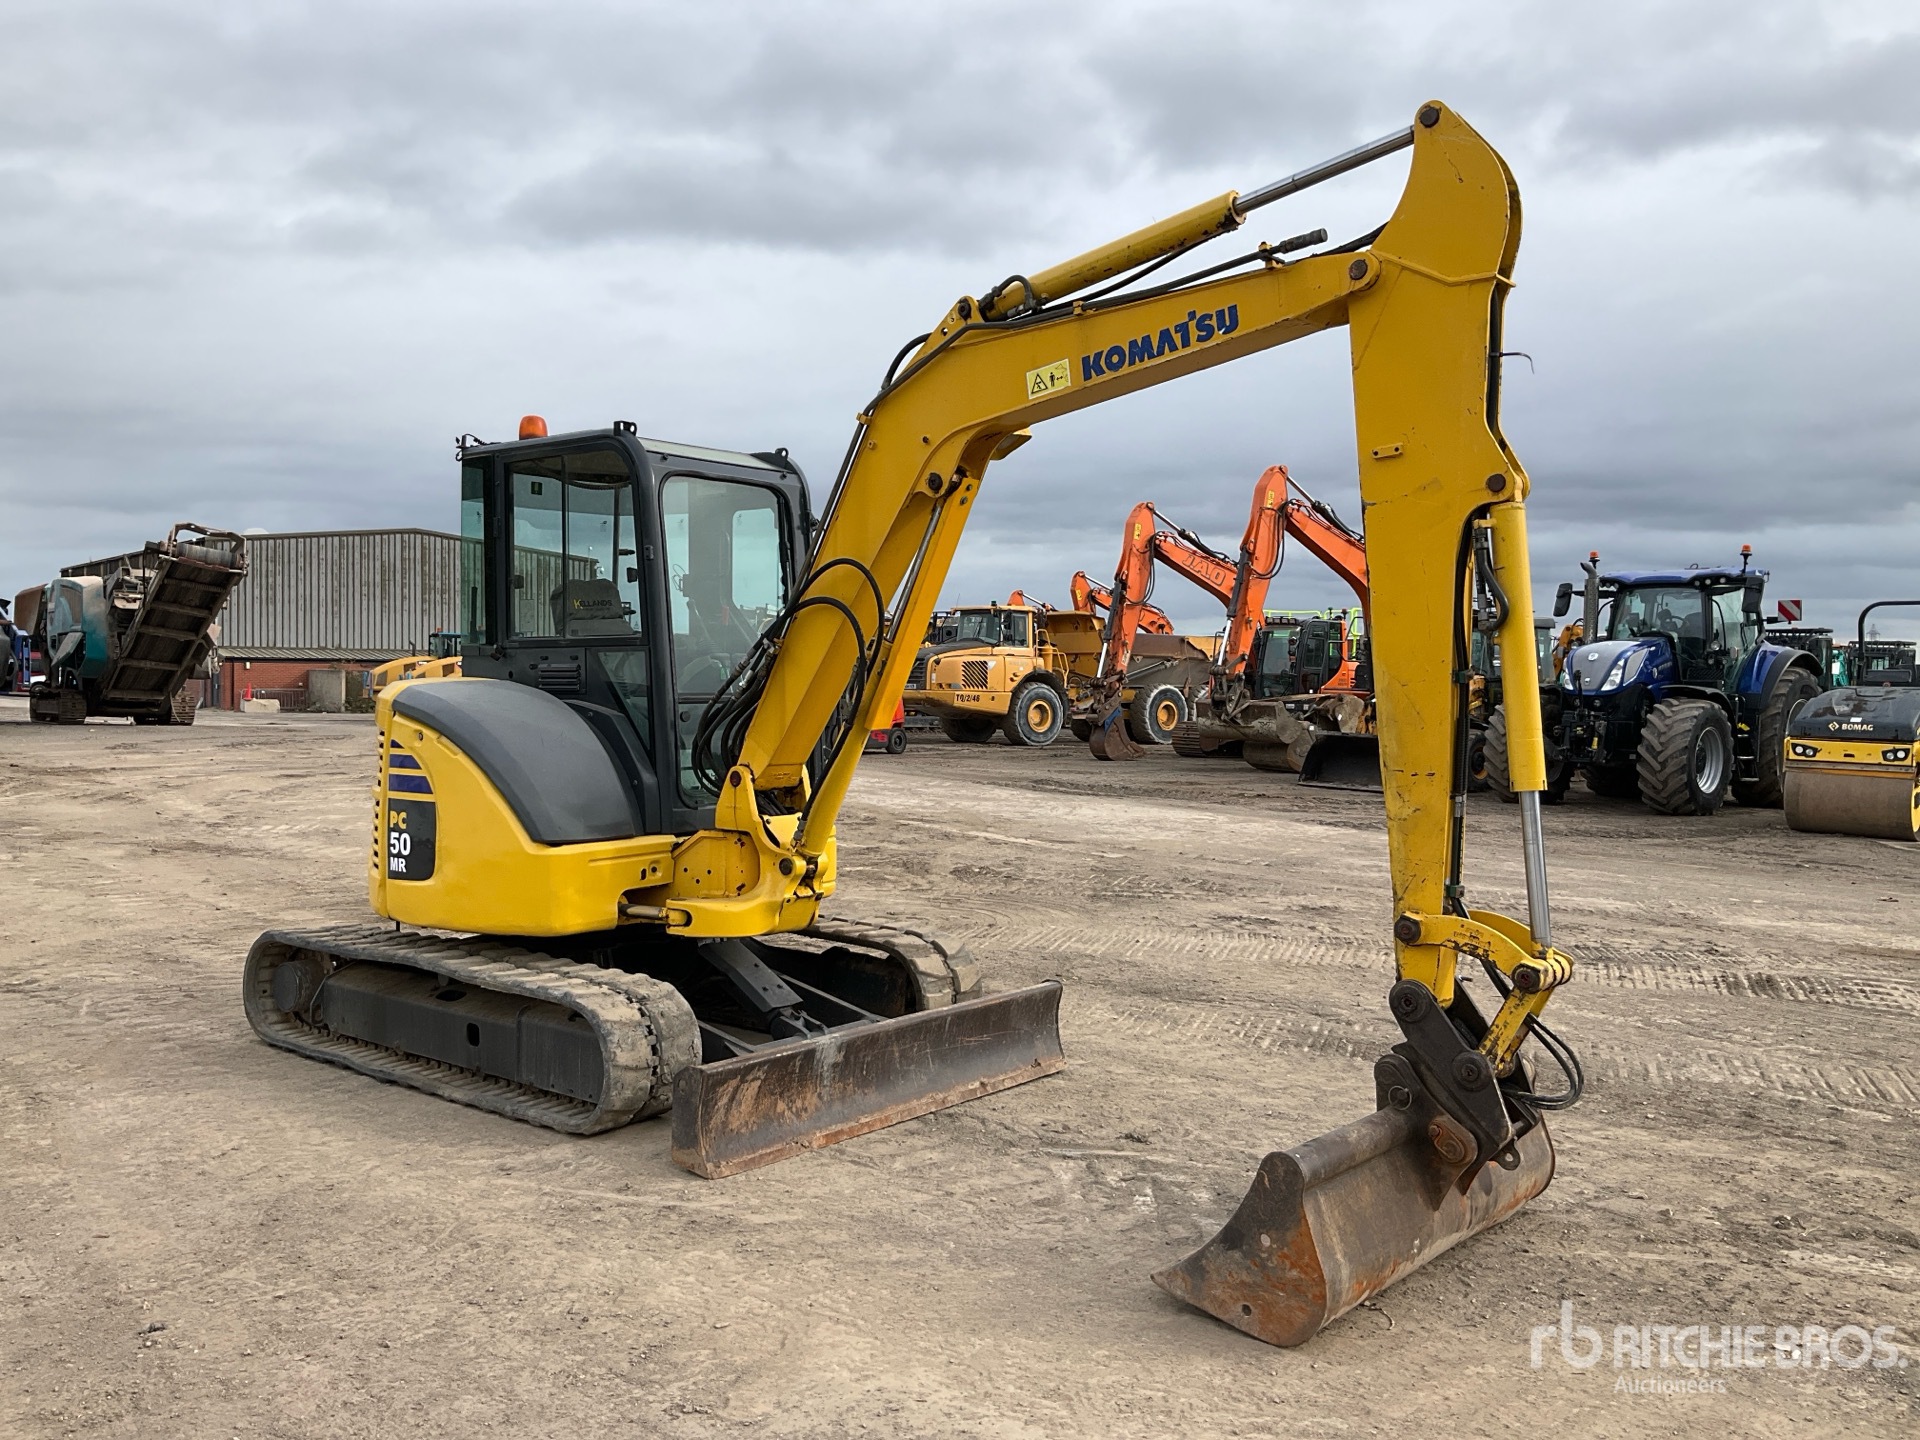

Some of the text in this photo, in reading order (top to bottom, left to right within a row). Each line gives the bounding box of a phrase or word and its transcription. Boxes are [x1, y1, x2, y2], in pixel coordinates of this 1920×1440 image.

[1082, 304, 1239, 382] KOMATSU
[573, 598, 613, 609] KELLANDS
[1841, 723, 1874, 731] BOMAG
[389, 810, 408, 830] PC
[389, 831, 411, 856] 50
[389, 856, 407, 873] MR
